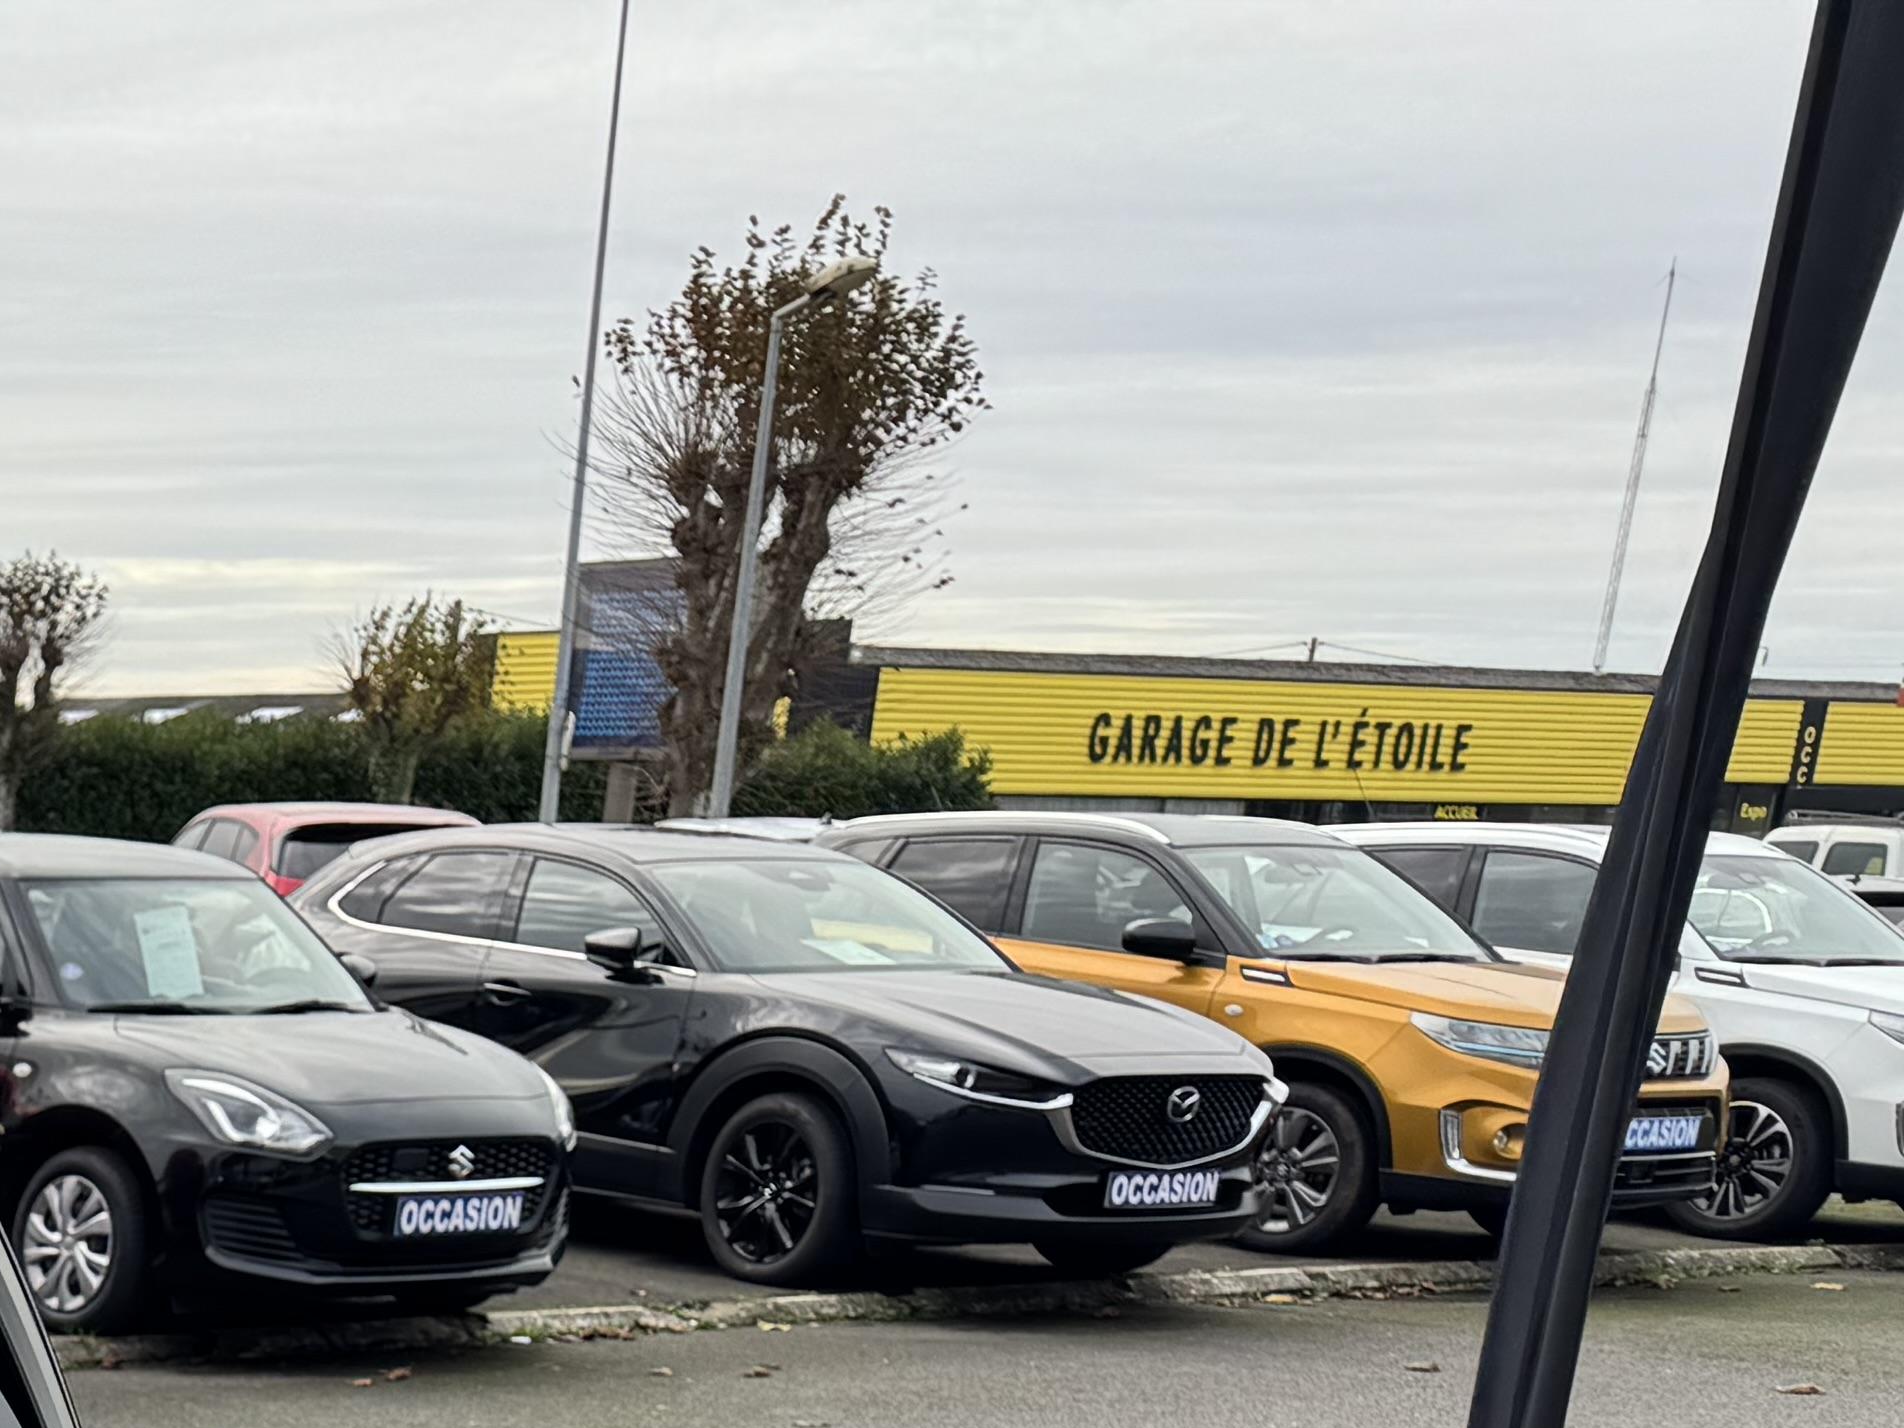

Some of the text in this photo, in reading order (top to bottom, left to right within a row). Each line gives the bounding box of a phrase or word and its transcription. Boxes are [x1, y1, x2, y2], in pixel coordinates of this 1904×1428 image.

[1088, 707, 1473, 772] GARAGE DE L'ÉTOILE
[1796, 726, 1817, 789] OCC
[1624, 1116, 1703, 1149] CCASION
[1111, 1170, 1220, 1206] OCCASION
[400, 1195, 524, 1235] OCCASION
